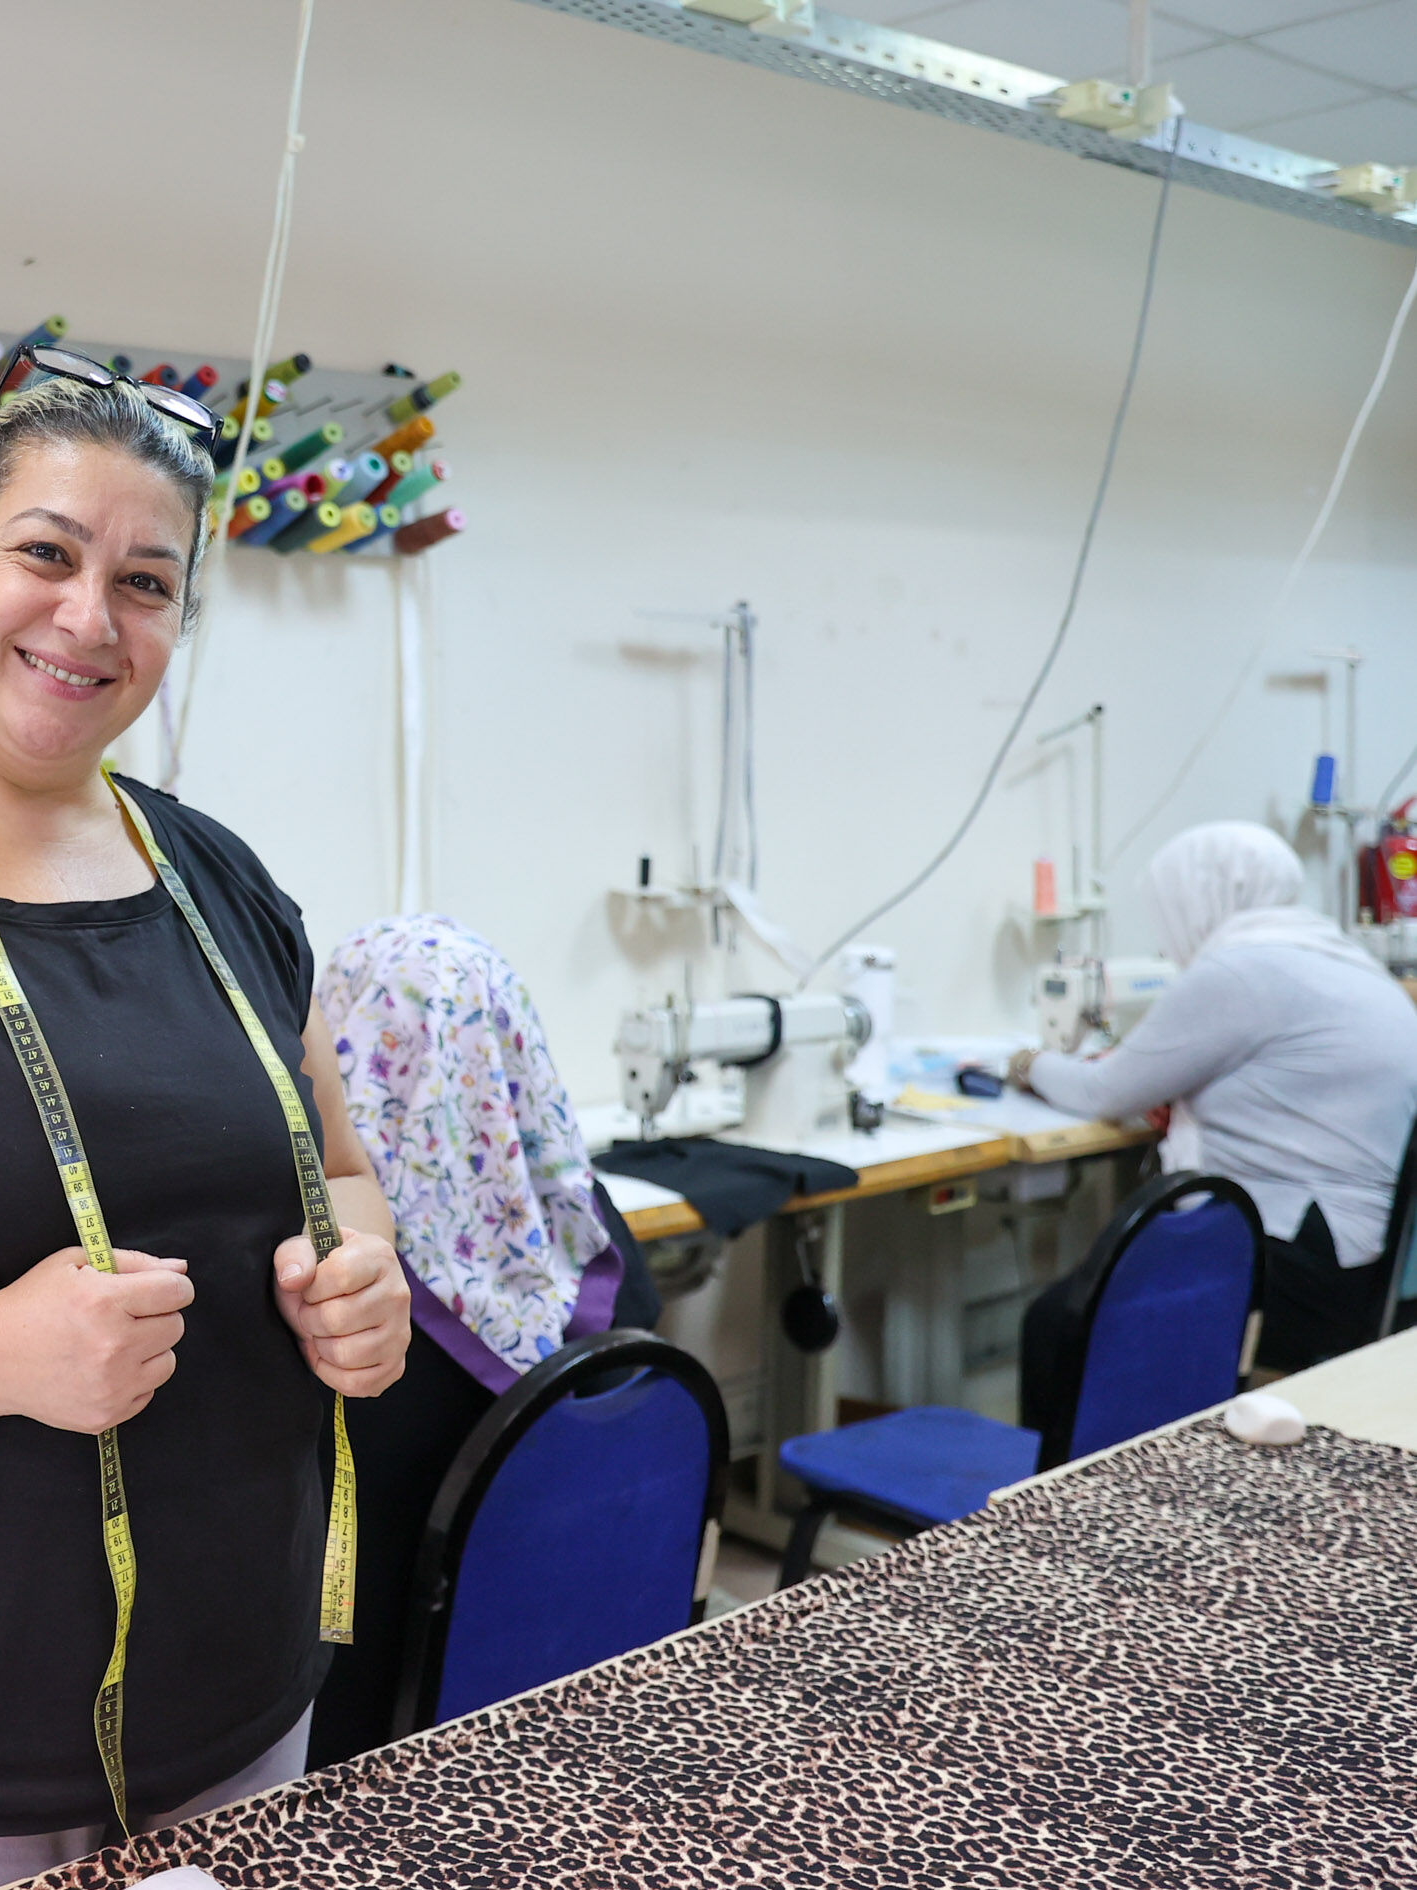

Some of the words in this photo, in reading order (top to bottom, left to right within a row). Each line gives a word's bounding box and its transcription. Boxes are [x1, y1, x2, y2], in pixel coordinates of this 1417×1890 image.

[4, 991, 14, 1000] 51
[9, 1006, 20, 1015] 50
[15, 1021, 25, 1030] 49
[20, 1036, 31, 1045] 48
[28, 1050, 38, 1059] 47
[32, 1066, 44, 1075] 46
[39, 1081, 50, 1091] 45
[46, 1097, 56, 1107] 44
[288, 1106, 298, 1114] 119
[51, 1114, 61, 1124] 43
[293, 1122, 303, 1130] 120
[56, 1131, 67, 1140] 42
[297, 1138, 308, 1146] 121
[63, 1148, 72, 1157] 41
[301, 1154, 312, 1163] 122
[68, 1165, 78, 1175] 40
[304, 1171, 316, 1180] 123
[74, 1183, 83, 1193] 39
[308, 1188, 320, 1197] 124
[79, 1200, 89, 1210] 38
[311, 1203, 325, 1213] 125
[86, 1217, 94, 1228] 37
[315, 1220, 329, 1230] 126
[90, 1235, 100, 1246] 36
[319, 1237, 332, 1247] 127
[95, 1254, 105, 1264] 35
[106, 1447, 112, 1458] 24
[107, 1465, 114, 1477] 23
[344, 1472, 351, 1484] 10
[109, 1482, 116, 1494] 22
[344, 1489, 348, 1500] 9
[111, 1500, 118, 1511] 21
[344, 1507, 348, 1518] 8
[112, 1518, 120, 1529] 20
[343, 1525, 347, 1536] 7
[114, 1537, 122, 1546] 19
[342, 1542, 346, 1553] 6
[118, 1554, 126, 1565] 18
[340, 1560, 345, 1571] 5
[122, 1572, 129, 1583] 17
[339, 1580, 345, 1588] 4
[338, 1595, 343, 1607] 3
[337, 1613, 342, 1623] 2
[105, 1703, 110, 1713] 9
[105, 1720, 110, 1730] 8
[107, 1739, 112, 1749] 7
[110, 1757, 114, 1766] 6
